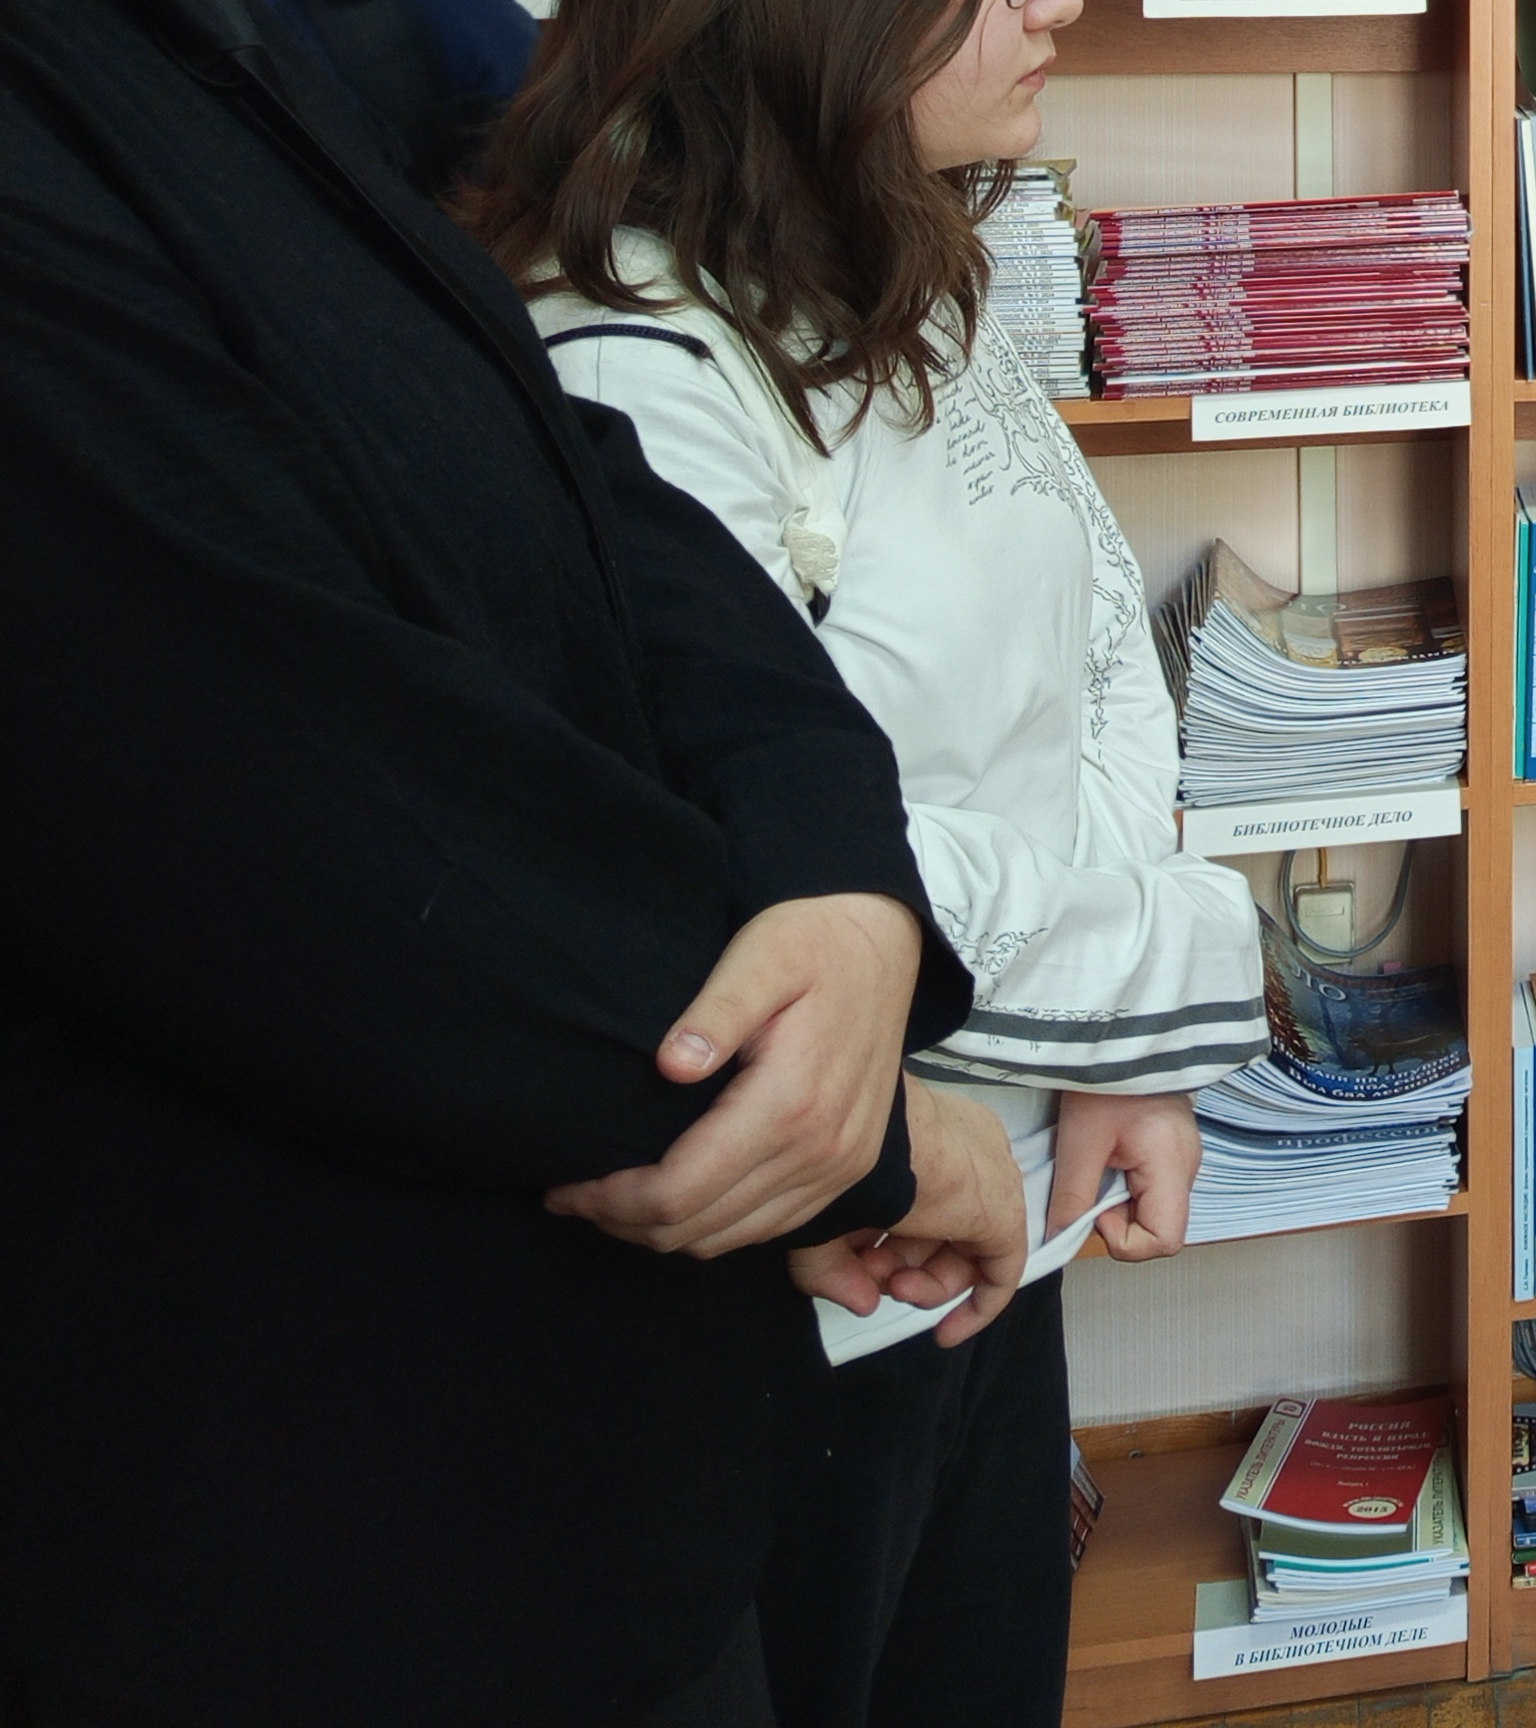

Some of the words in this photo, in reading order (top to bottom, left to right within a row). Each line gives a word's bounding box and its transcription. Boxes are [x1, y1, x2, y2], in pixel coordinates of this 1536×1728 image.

[1214, 405, 1340, 425] СОВРЕМЕННАЯ
[1343, 399, 1450, 417] БИБЛИОТЕКА
[1232, 814, 1366, 838] БИБЛИОТЕЧНОЕ
[1369, 810, 1413, 826] ДЕЛО
[1289, 1616, 1373, 1639] МОЛОДЫЕ
[1234, 1651, 1247, 1666] В
[1248, 1632, 1385, 1664] БИБЛИОТЕЧНОМ
[1384, 1627, 1429, 1646] ДЕЛЕ
